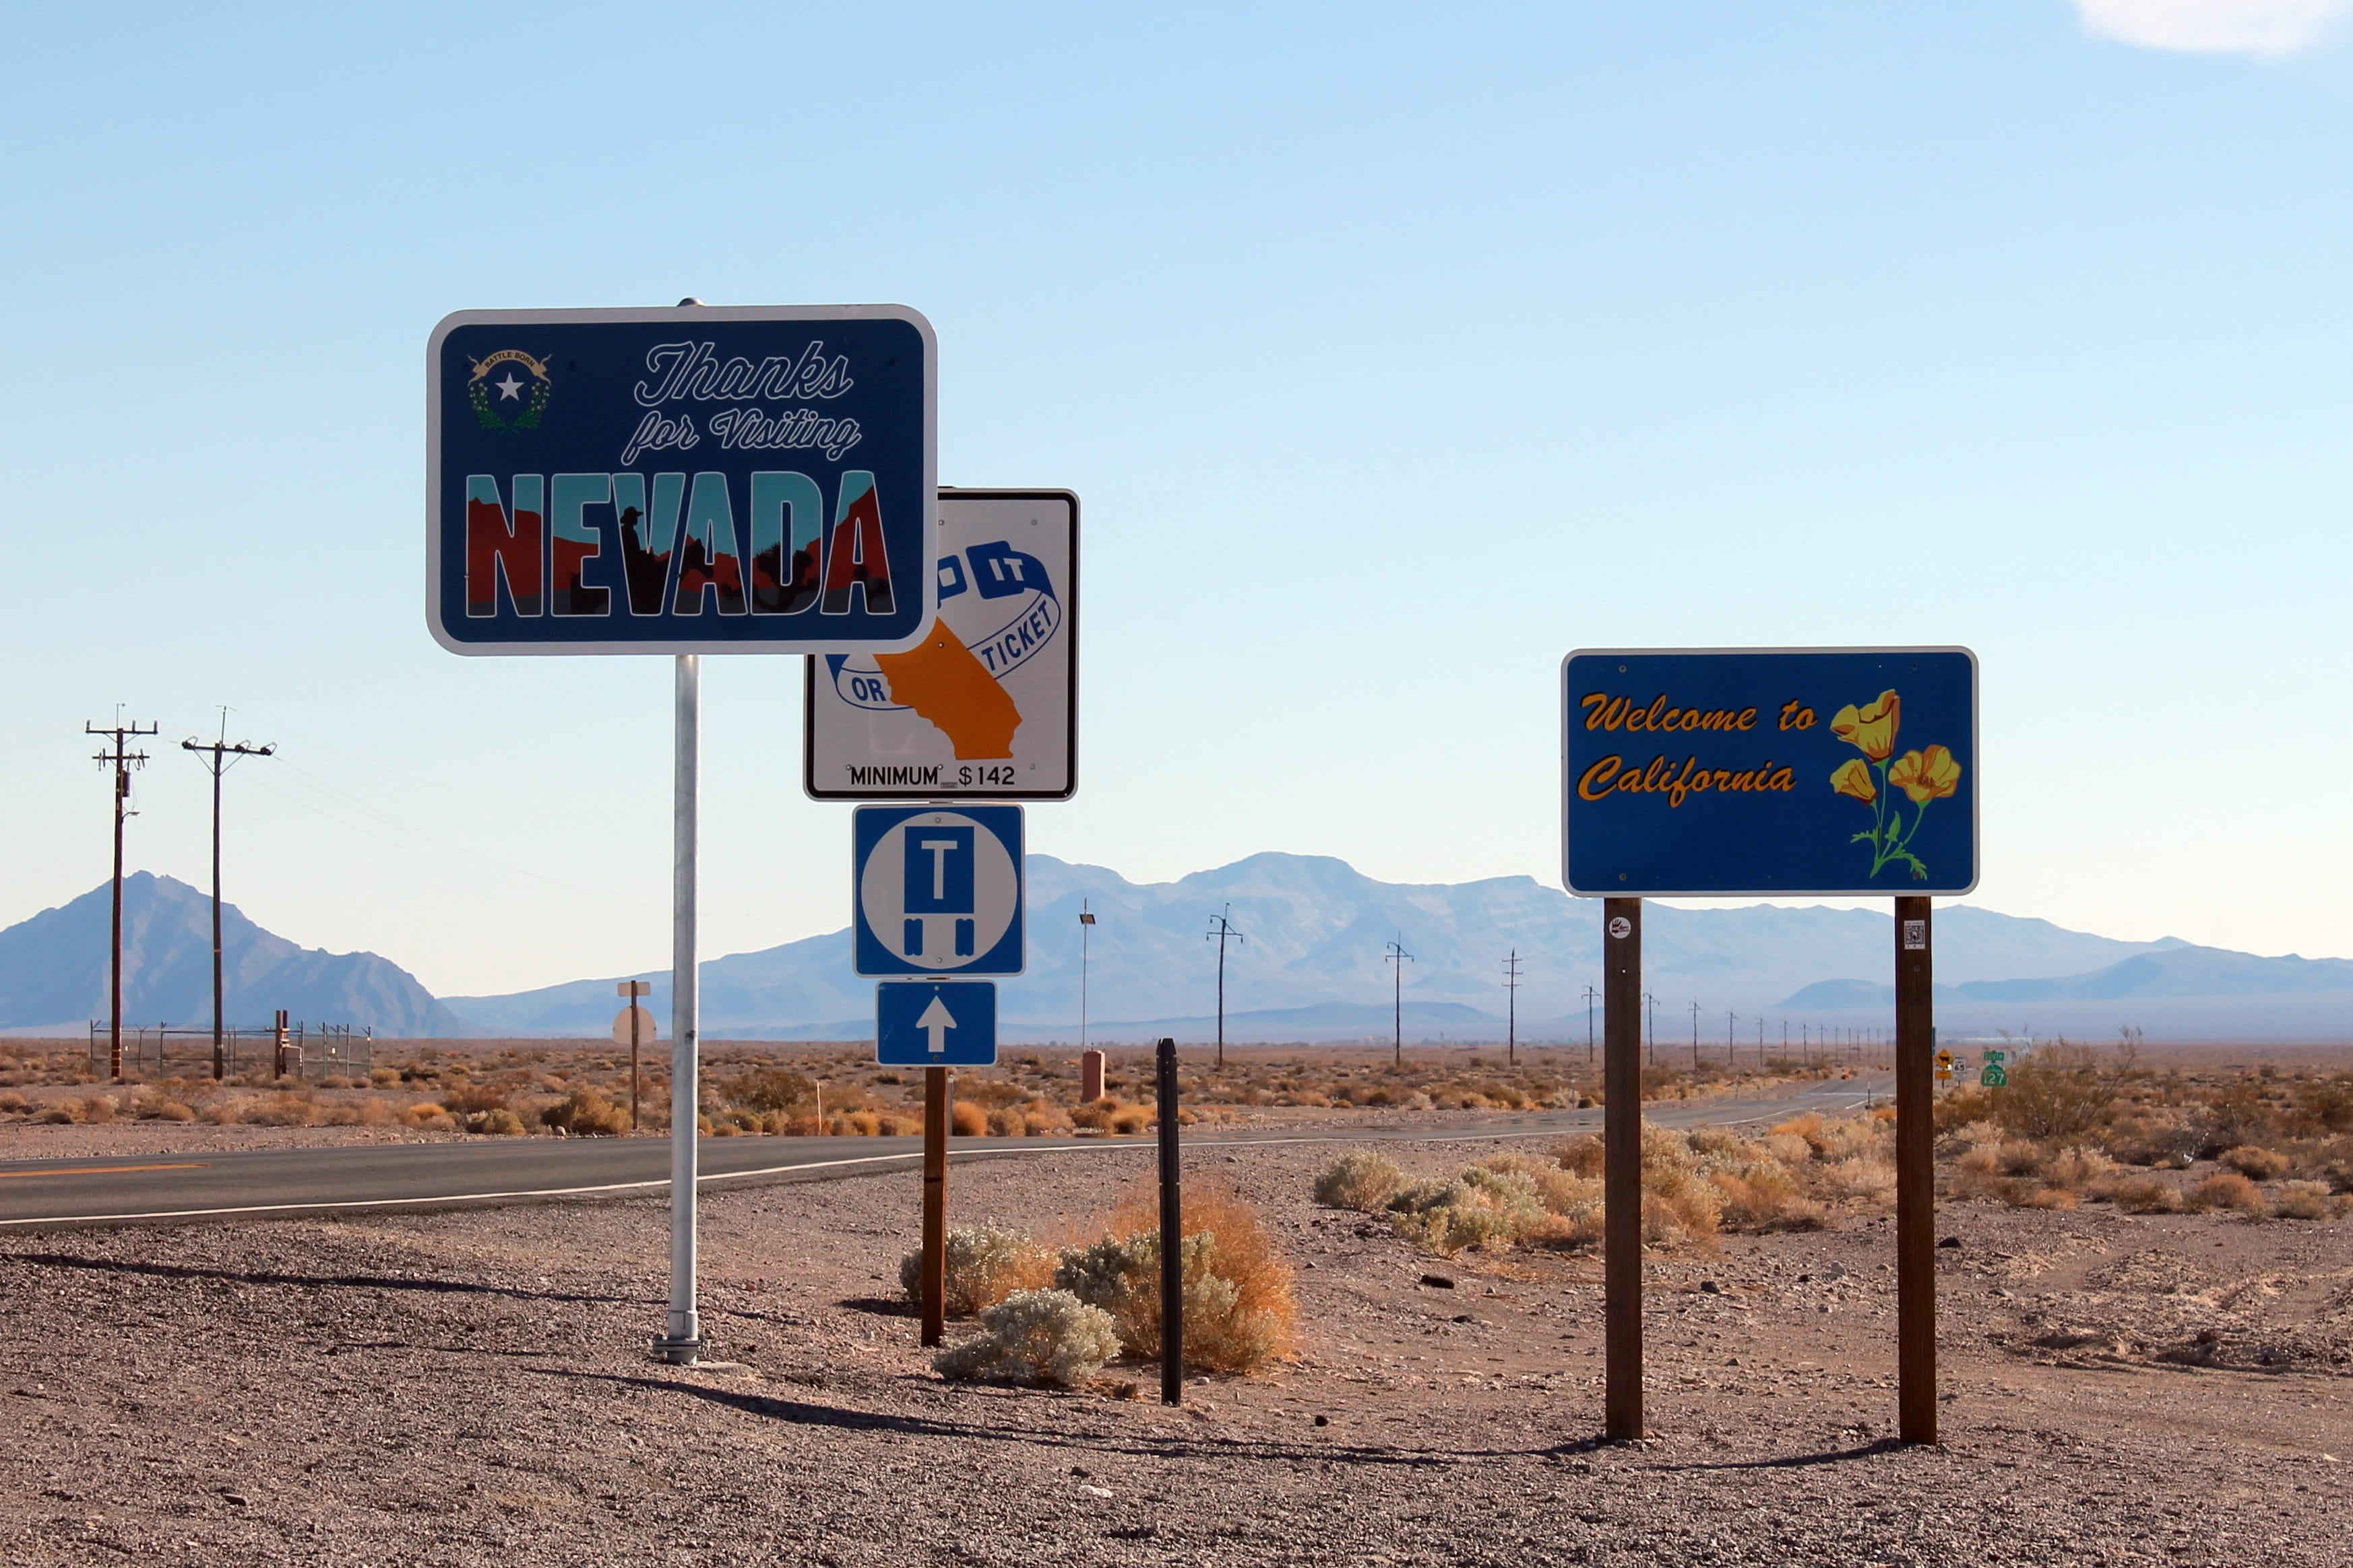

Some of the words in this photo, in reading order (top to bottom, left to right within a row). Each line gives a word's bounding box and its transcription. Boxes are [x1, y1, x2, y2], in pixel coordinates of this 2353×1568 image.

[485, 351, 512, 368] BATTLE
[514, 352, 535, 367] BORN
[634, 340, 854, 407] Thanks
[621, 410, 700, 466] for
[709, 408, 862, 462] Visiting
[466, 470, 896, 618] NEVADA
[988, 557, 1025, 582] IT
[851, 677, 887, 701] OR
[980, 599, 1052, 672] TICKET
[1580, 691, 1758, 732] Welcome
[1778, 698, 1818, 731] to
[850, 766, 938, 786] MINIMUM
[958, 765, 1015, 787] $142
[1577, 754, 1797, 809] California
[920, 840, 958, 900] T
[1984, 1073, 2005, 1084] 127
